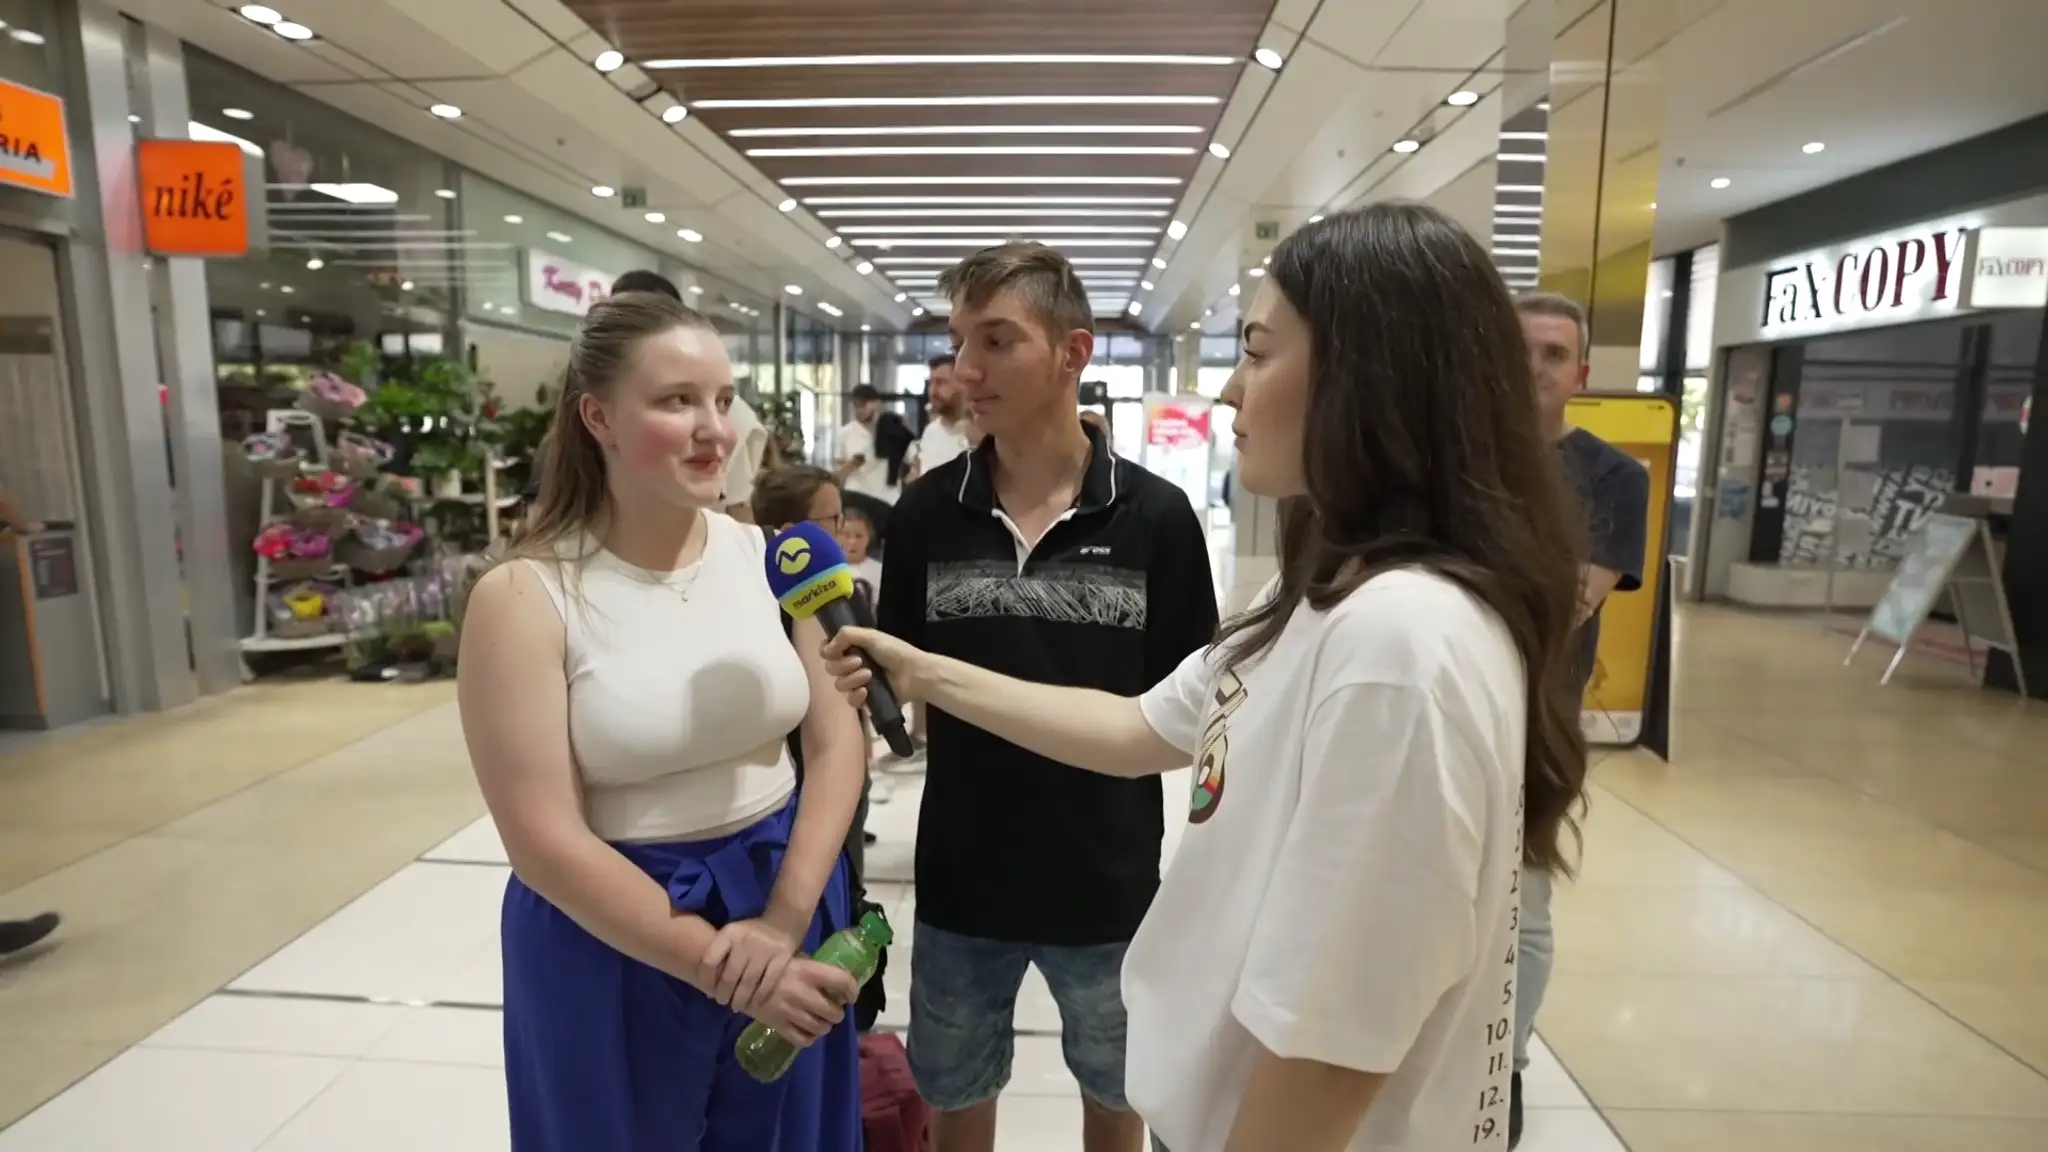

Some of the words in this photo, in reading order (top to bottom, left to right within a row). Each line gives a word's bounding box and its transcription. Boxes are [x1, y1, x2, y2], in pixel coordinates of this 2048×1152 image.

[154, 171, 234, 221] niké
[793, 580, 836, 609] markiza
[1479, 1085, 1505, 1112] 12.
[1473, 1117, 1501, 1144] 19.
